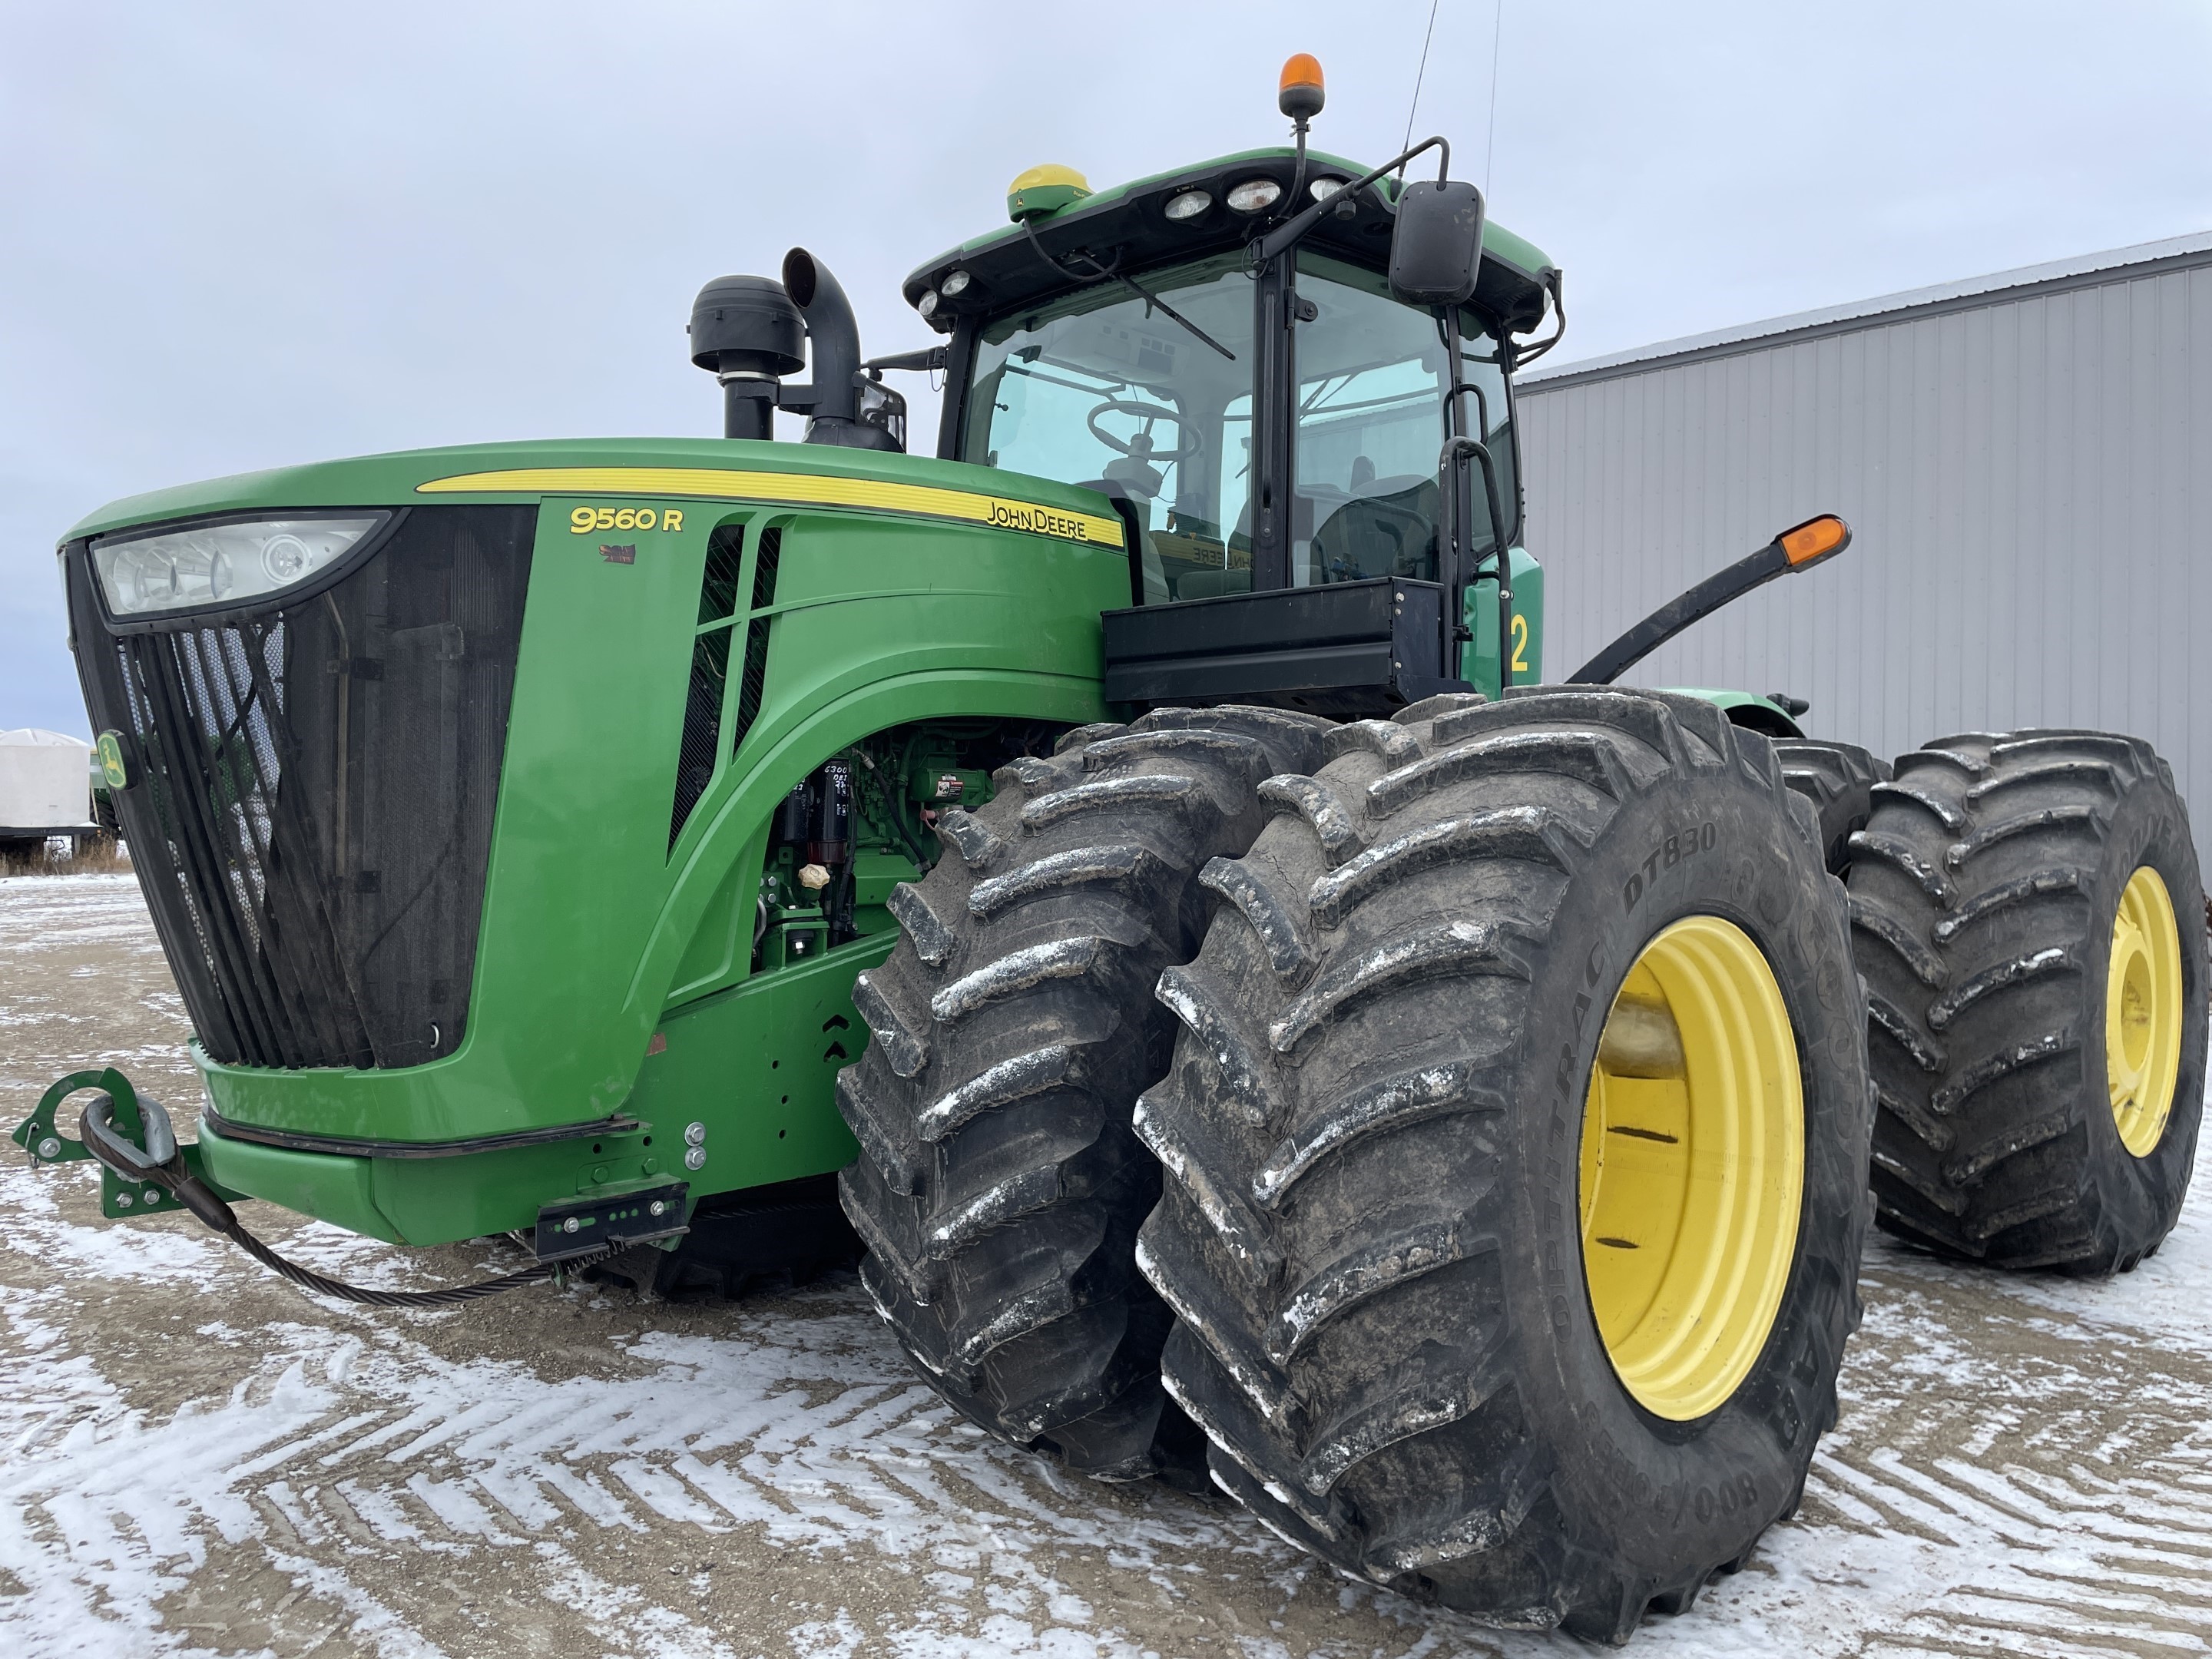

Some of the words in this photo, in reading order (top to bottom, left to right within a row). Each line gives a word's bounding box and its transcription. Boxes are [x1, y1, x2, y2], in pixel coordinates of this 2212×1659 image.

[570, 505, 657, 535] 9560
[662, 508, 684, 533] R
[987, 502, 1031, 530] JOHN
[1034, 509, 1087, 539] DEERE
[1511, 614, 1528, 672] 2
[824, 765, 848, 773] 6300
[1544, 939, 1606, 1344] OPTITRAC
[1622, 822, 1717, 917] DT830
